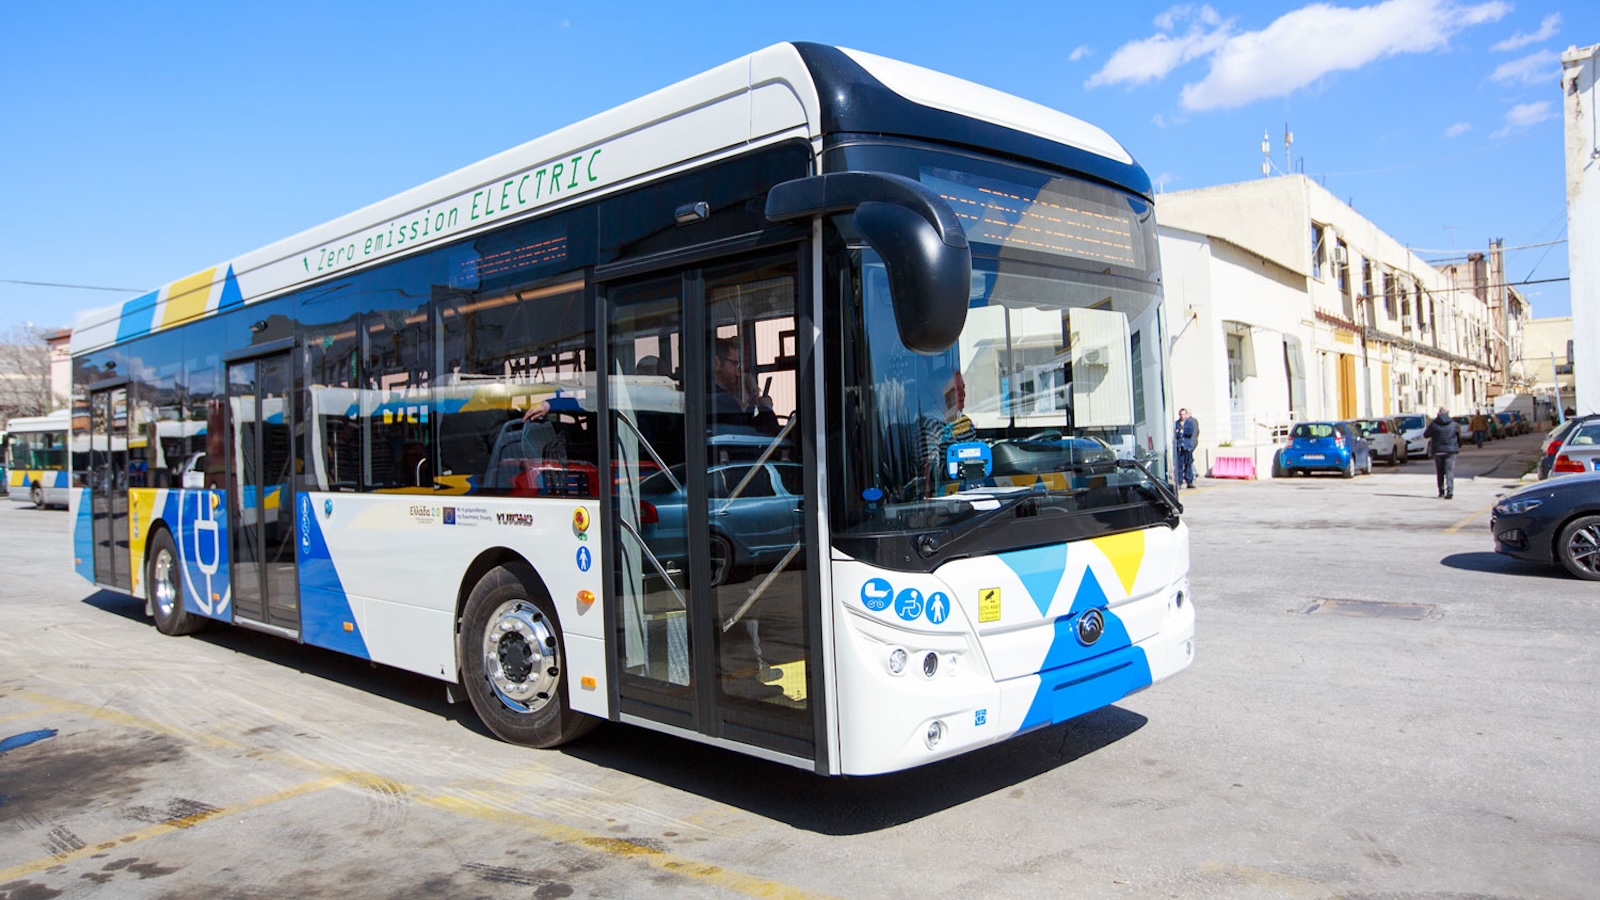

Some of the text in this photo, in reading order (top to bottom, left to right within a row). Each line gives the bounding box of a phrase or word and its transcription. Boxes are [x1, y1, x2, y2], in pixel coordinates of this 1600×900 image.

[317, 148, 602, 272] Zero emission ELECTRIC
